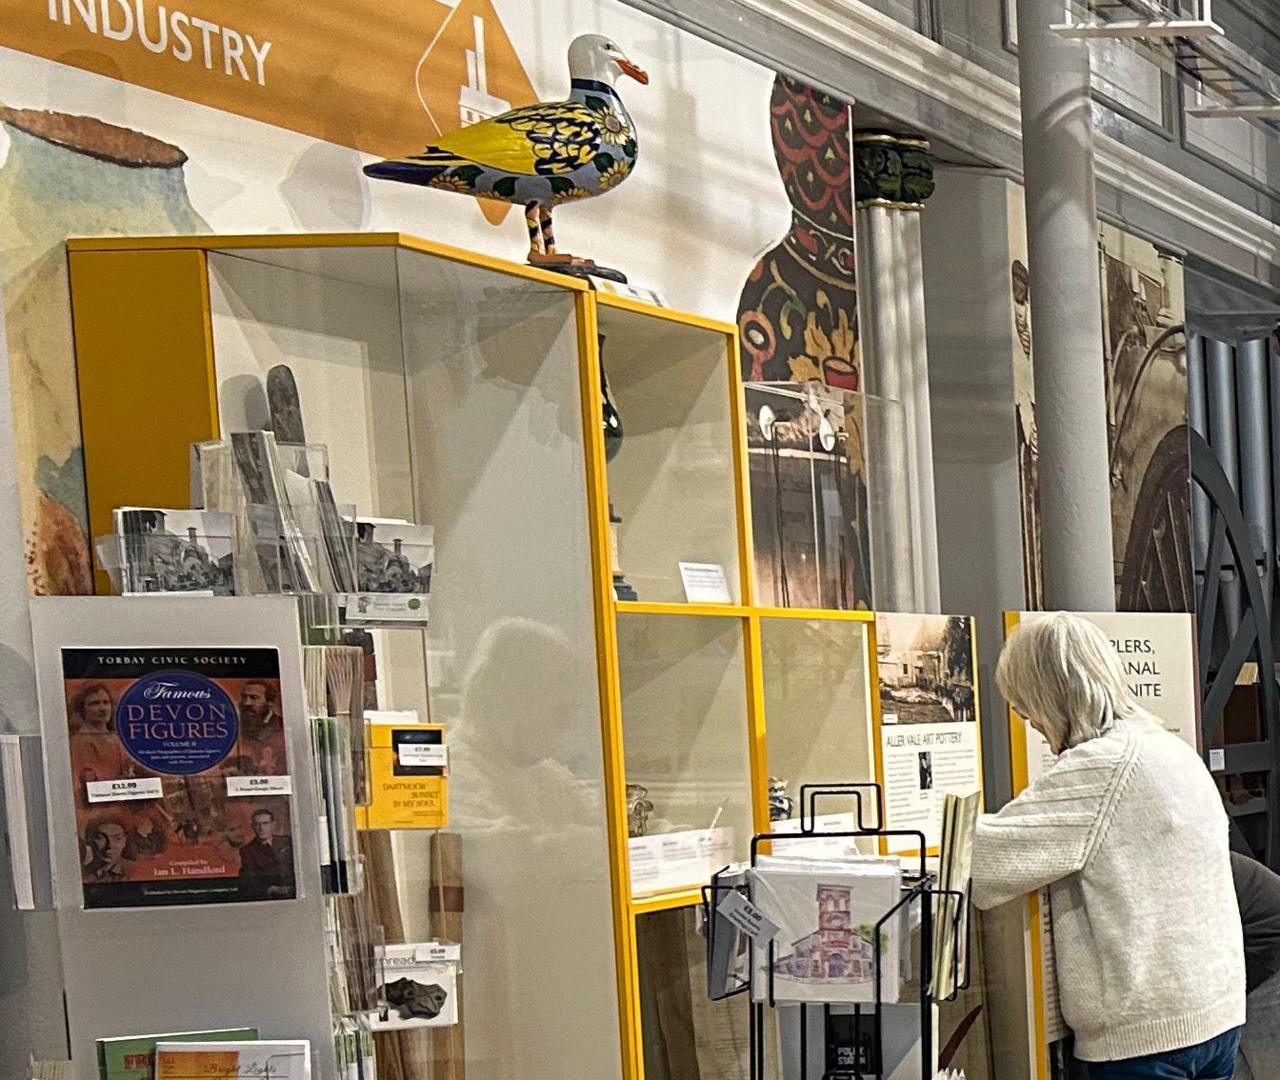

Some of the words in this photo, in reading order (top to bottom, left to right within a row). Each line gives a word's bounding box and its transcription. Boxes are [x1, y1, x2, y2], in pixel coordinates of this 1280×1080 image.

[47, 0, 273, 87] INDUSTRY
[98, 656, 146, 665] TORBAY
[152, 656, 188, 664] CIVIC
[193, 656, 248, 664] SOCIETY
[143, 681, 212, 700] Famous
[126, 703, 227, 722] DEVON
[129, 721, 229, 740] FIGURES
